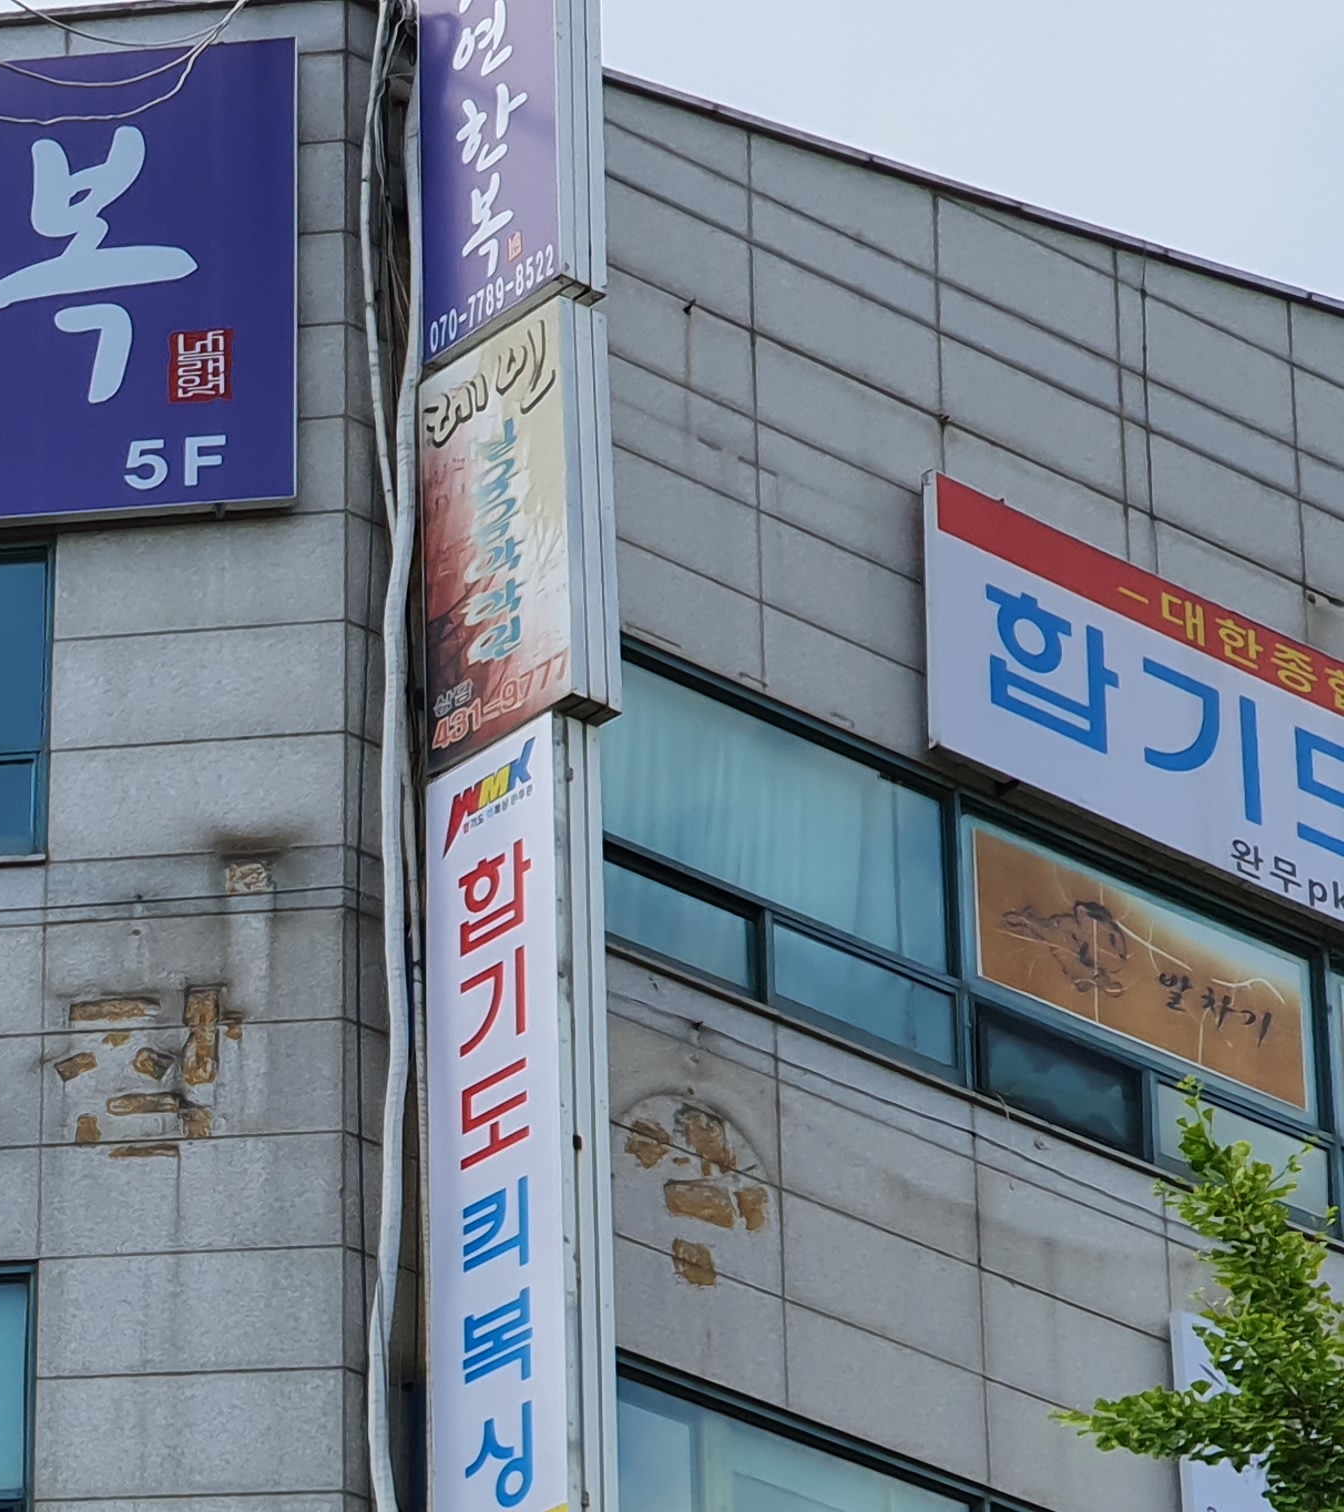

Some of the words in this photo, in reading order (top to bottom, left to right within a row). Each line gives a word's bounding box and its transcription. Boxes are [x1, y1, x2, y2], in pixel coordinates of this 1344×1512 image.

[453, 0, 528, 278] 연한복
[429, 244, 555, 353] 070-7789-8522
[123, 433, 229, 490] 5F
[432, 647, 569, 750] 431-9777
[442, 736, 536, 859] WMK
[458, 838, 532, 1171] 합기도
[462, 1175, 534, 1509] 킥복싱
